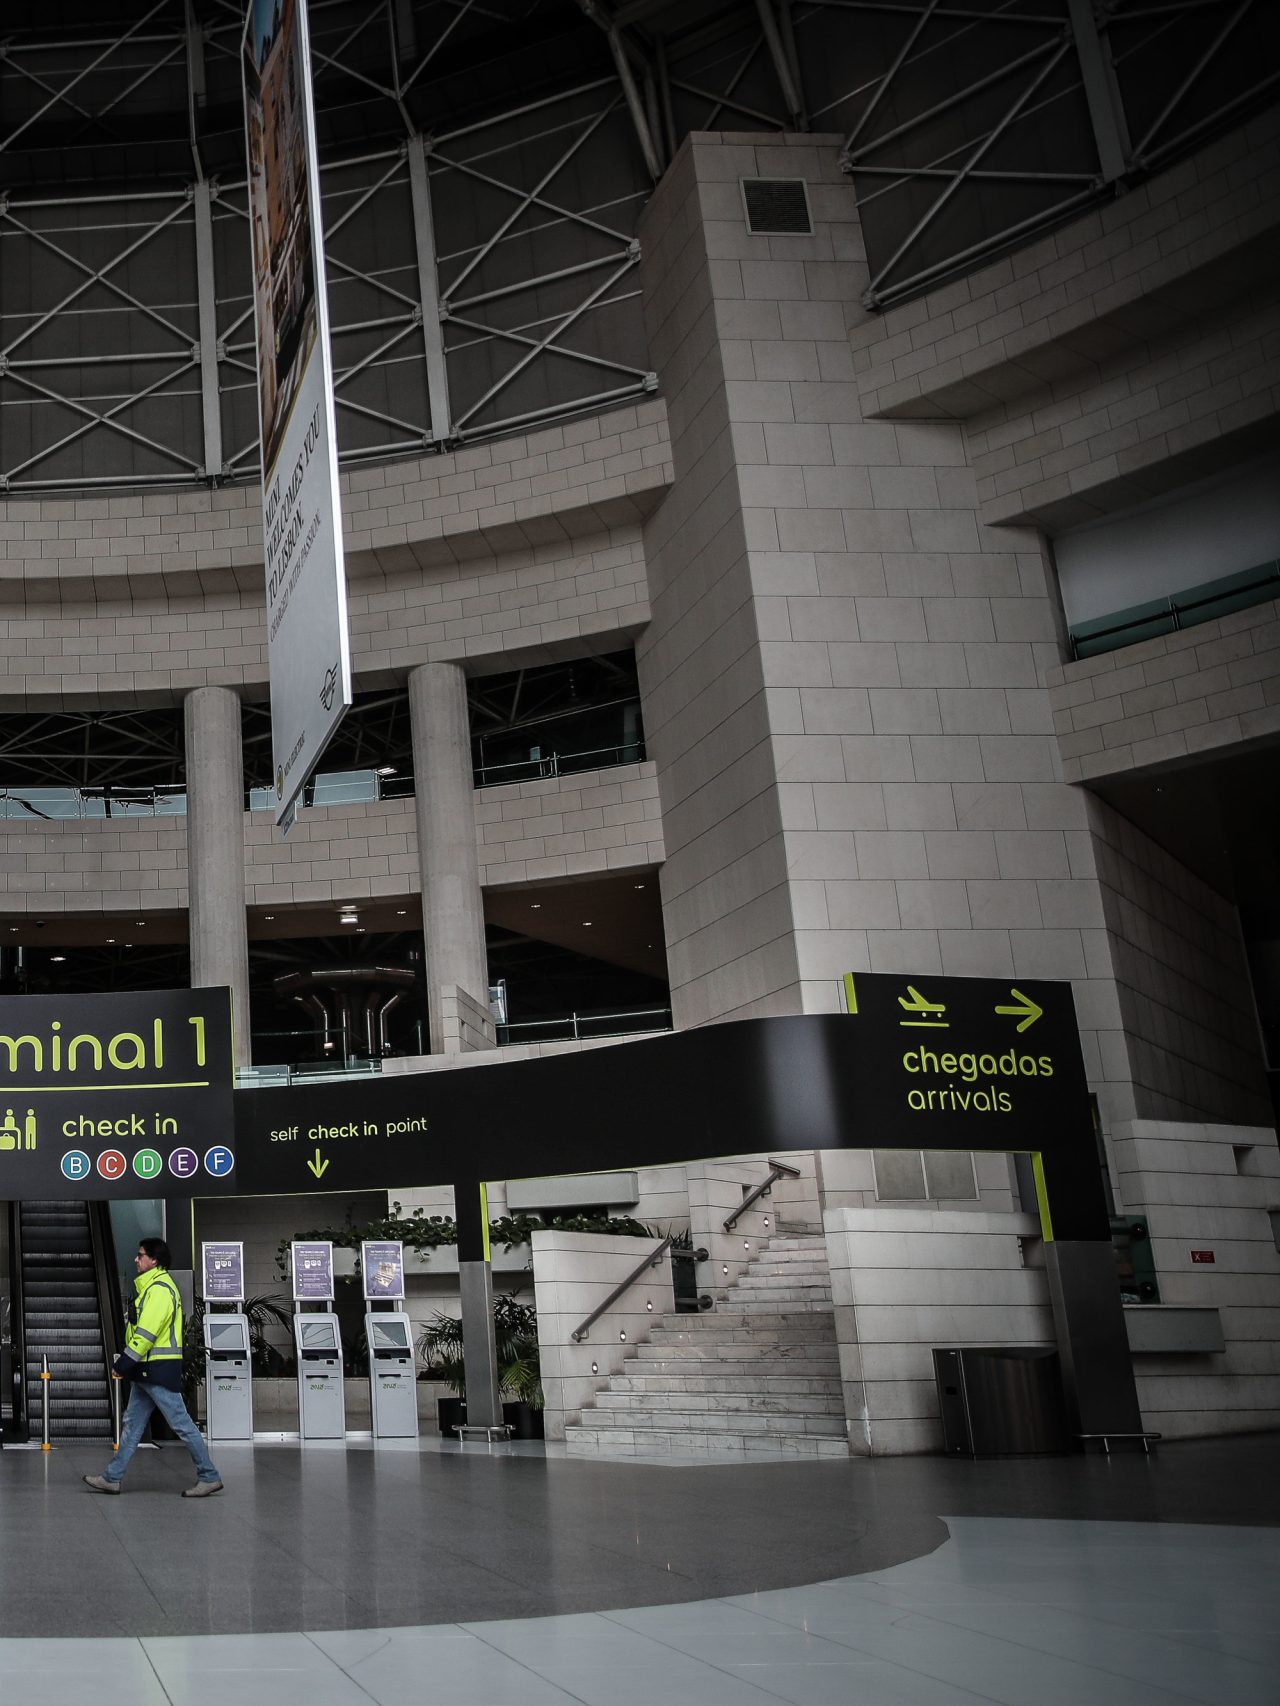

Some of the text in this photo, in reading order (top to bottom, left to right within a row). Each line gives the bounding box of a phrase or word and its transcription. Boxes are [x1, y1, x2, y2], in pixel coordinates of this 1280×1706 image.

[267, 403, 320, 568] WELCOMES YOU
[265, 474, 280, 536] MINI
[268, 501, 304, 608] TO LISBON.
[289, 556, 301, 596] WITH
[188, 1016, 206, 1067] 1
[903, 1045, 1054, 1082] chegadas
[907, 1083, 1012, 1112] arrivals
[62, 1112, 178, 1137] check in
[270, 1117, 428, 1142] self check in point
[70, 1152, 225, 1174] B C D E F
